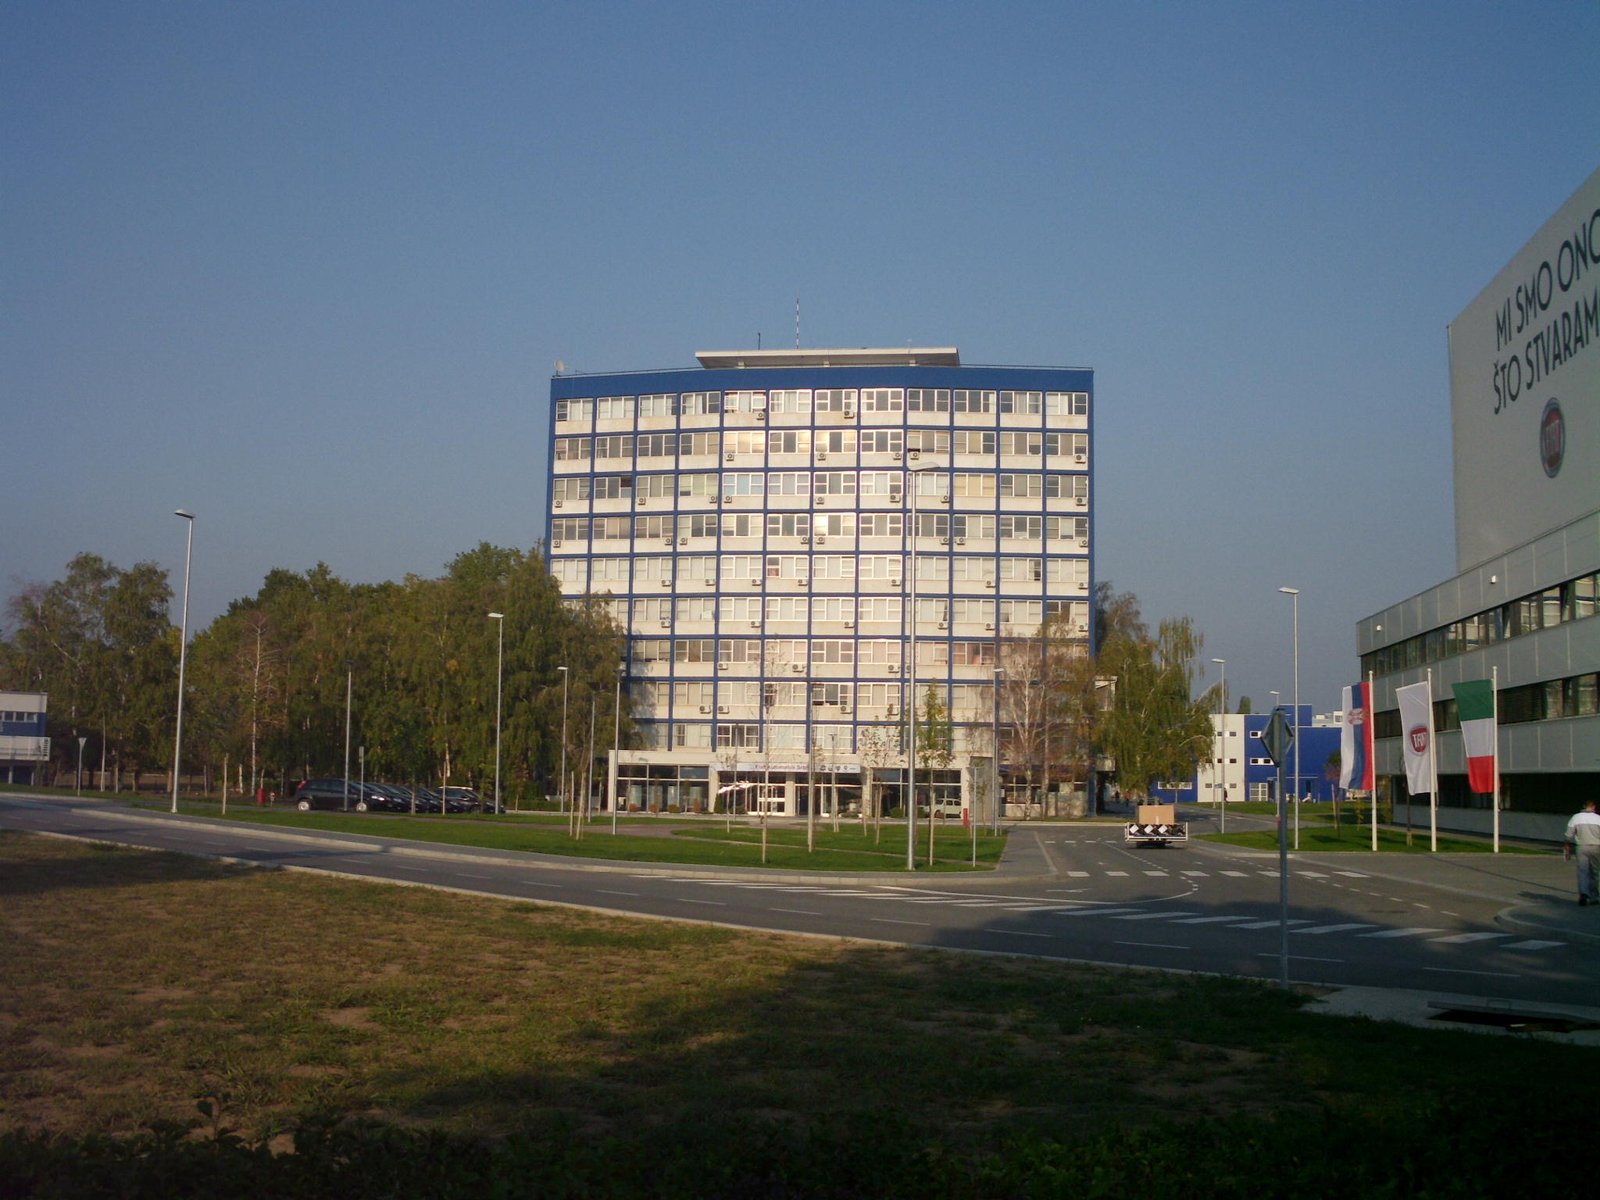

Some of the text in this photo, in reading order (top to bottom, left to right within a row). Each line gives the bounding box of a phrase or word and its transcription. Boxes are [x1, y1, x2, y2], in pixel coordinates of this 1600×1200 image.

[1495, 297, 1512, 352] MI
[1516, 261, 1553, 334] SMO
[1494, 355, 1522, 415] ŠTO
